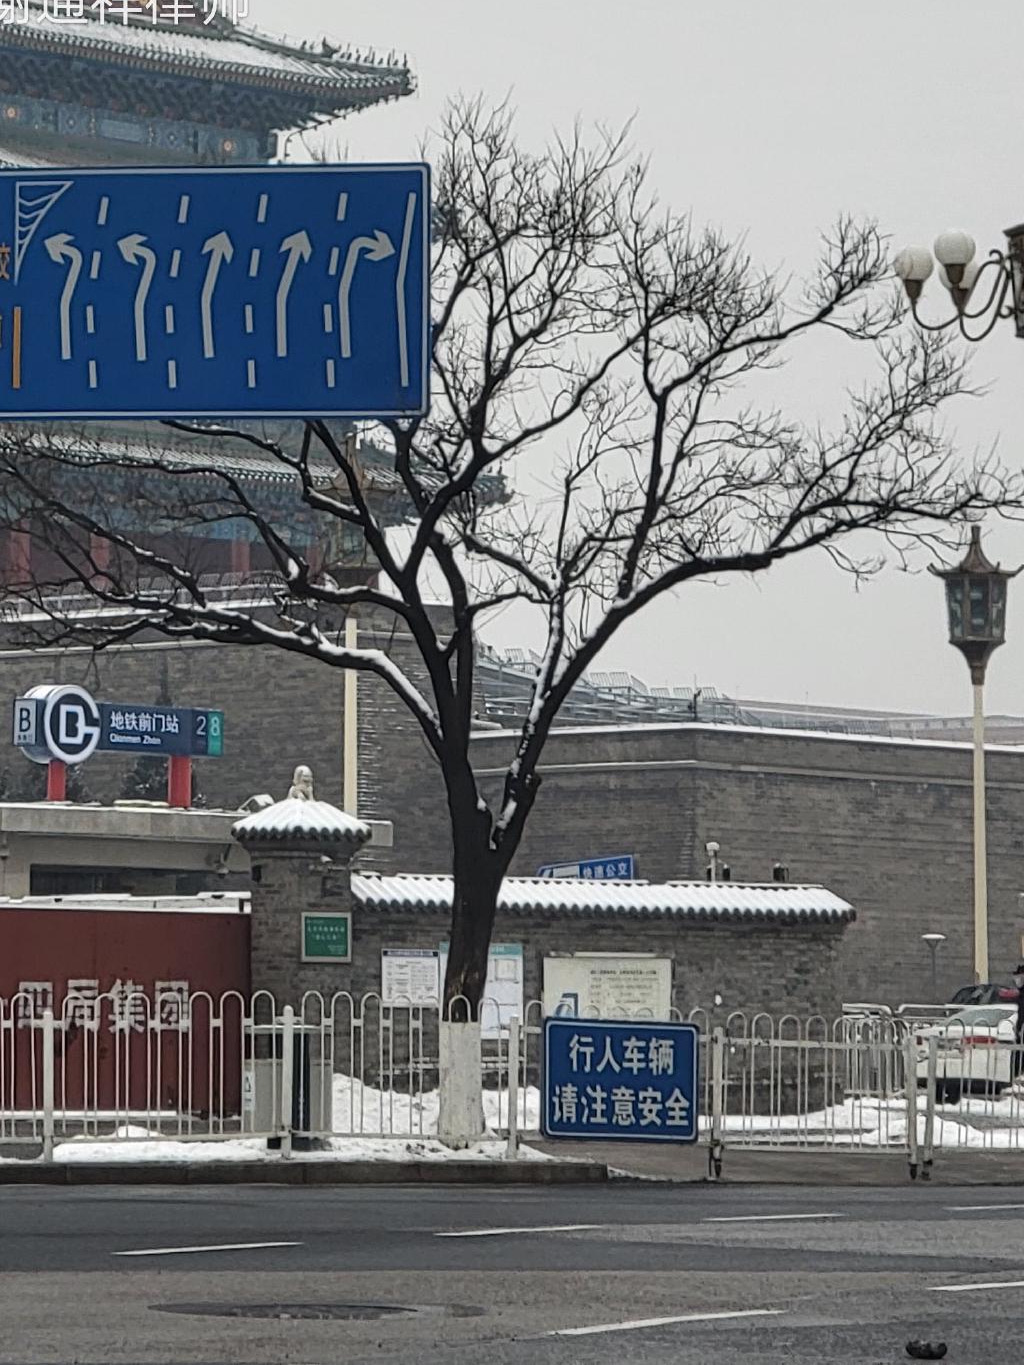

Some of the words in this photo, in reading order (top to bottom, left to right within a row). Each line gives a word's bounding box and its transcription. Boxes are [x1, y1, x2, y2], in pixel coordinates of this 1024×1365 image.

[19, 707, 31, 733] B
[110, 710, 180, 734] 地铁前门站
[196, 716, 207, 736] 2
[211, 717, 220, 737] 8
[569, 1034, 675, 1076] 行人车辆
[552, 1083, 690, 1127] 请注意安全
